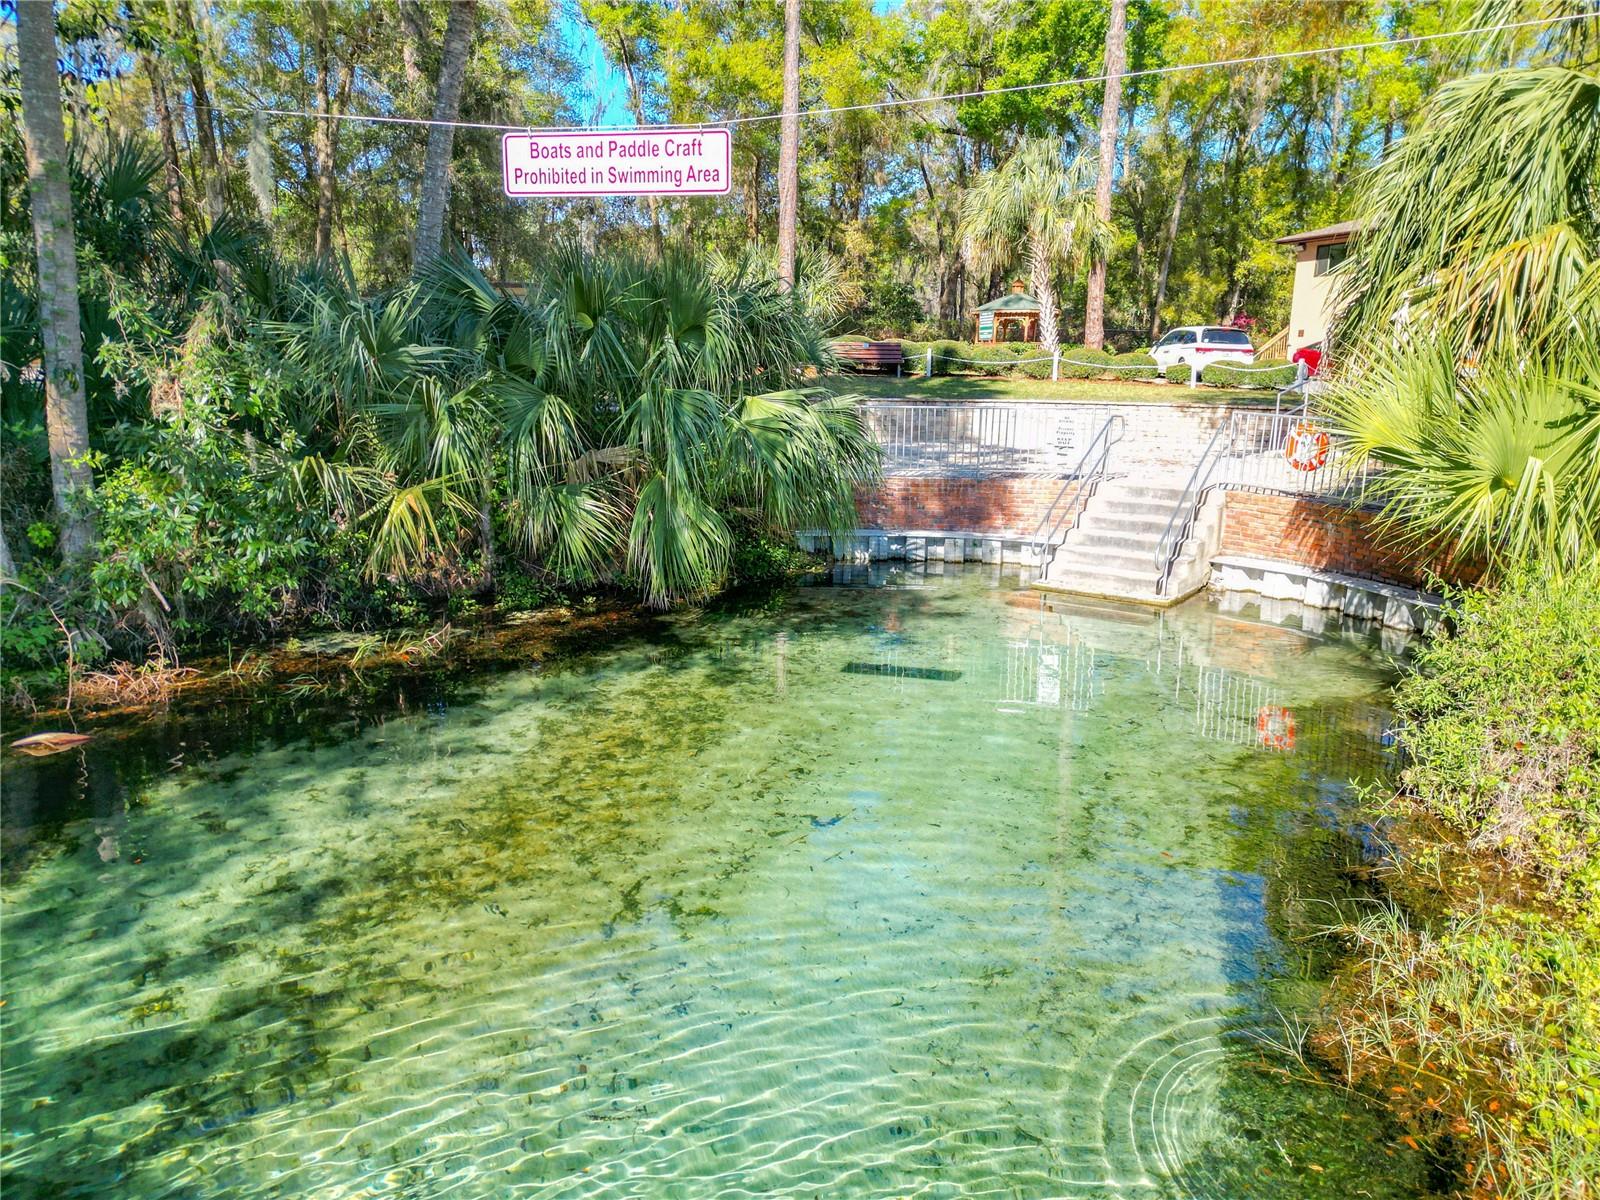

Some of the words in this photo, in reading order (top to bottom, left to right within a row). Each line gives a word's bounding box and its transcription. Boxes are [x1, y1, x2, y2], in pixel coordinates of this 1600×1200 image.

[530, 142, 572, 159] Boats
[576, 141, 603, 158] and
[609, 140, 660, 158] Paddle
[664, 138, 702, 157] Craft
[514, 167, 586, 185] Prohibited
[591, 167, 604, 183] in
[608, 166, 682, 187] Swimming
[686, 165, 720, 182] Area
